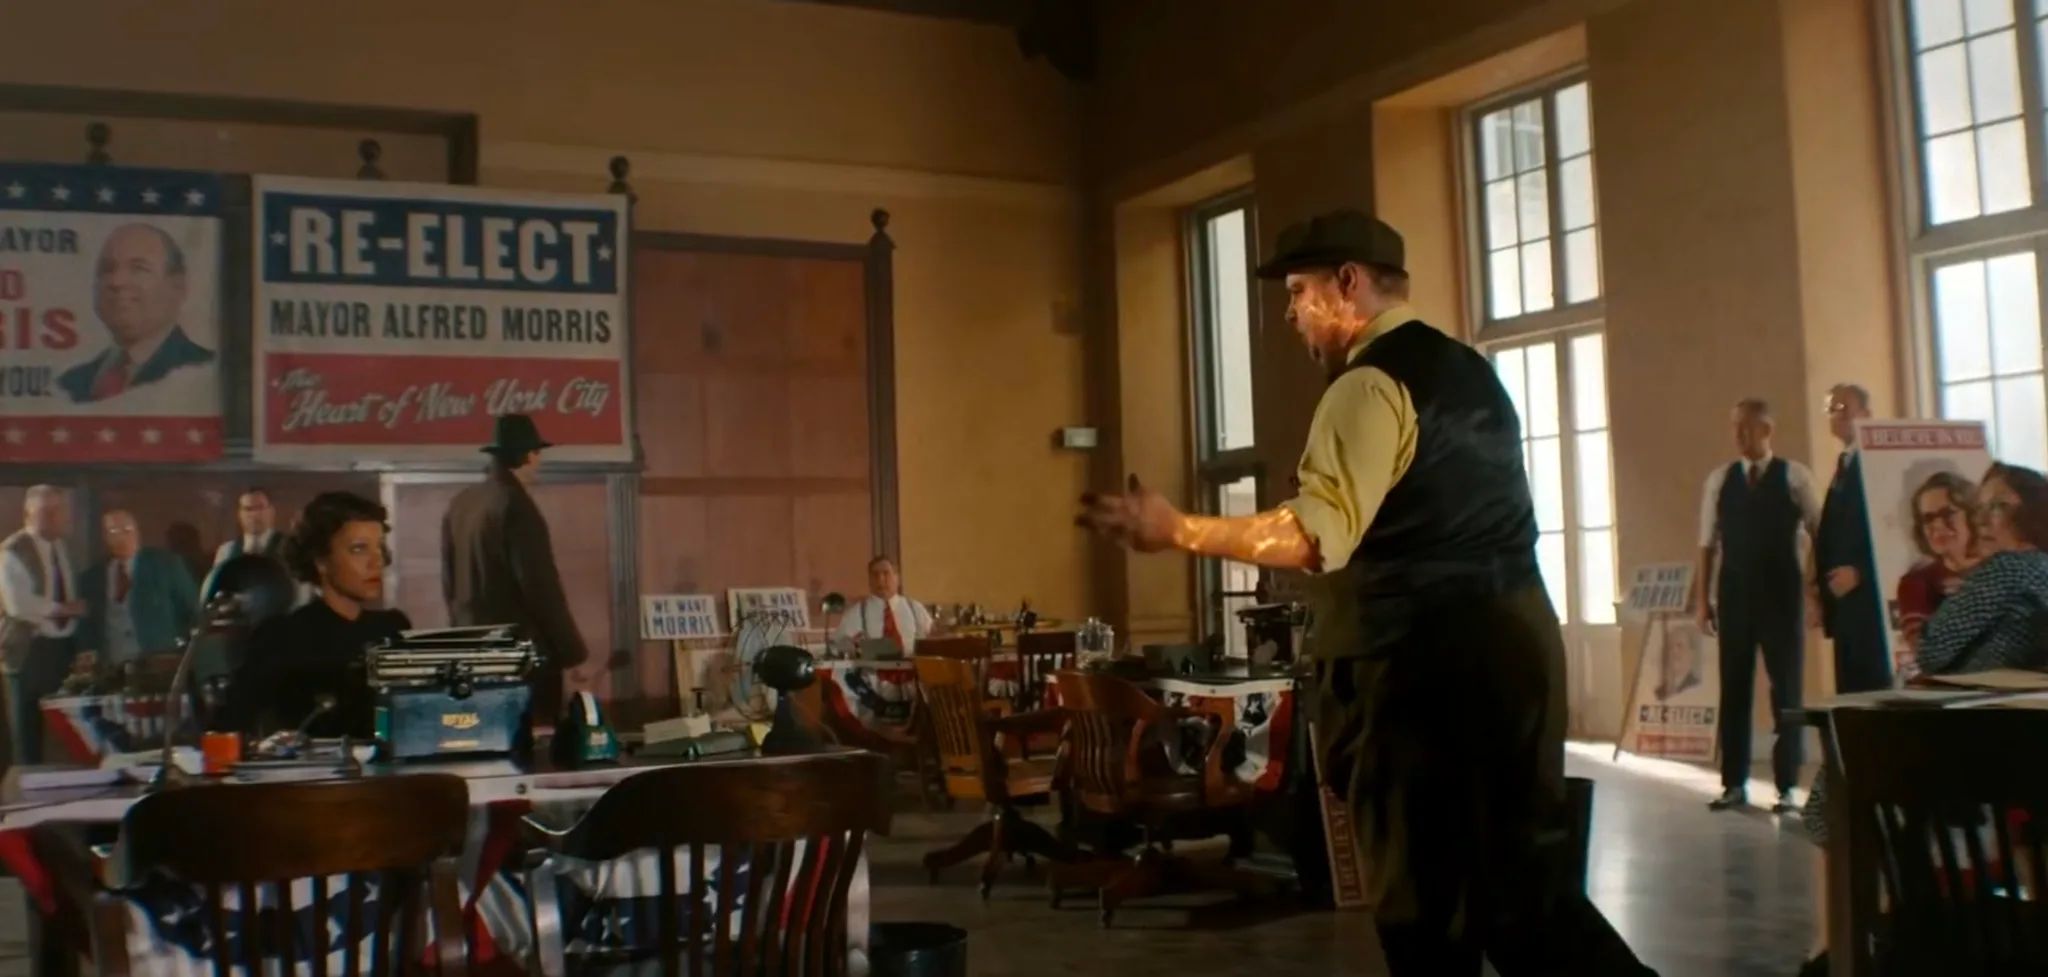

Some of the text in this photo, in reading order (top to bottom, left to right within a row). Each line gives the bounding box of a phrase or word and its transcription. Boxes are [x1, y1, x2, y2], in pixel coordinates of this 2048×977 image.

[289, 206, 599, 284] RE-ELECT
[0, 308, 79, 352] IS
[270, 300, 611, 345] MAYOR ALFRED MORRIS
[281, 376, 609, 431] Heart of New York City
[653, 600, 708, 612] WE WANT
[1630, 585, 1686, 609] MORRIS
[652, 615, 714, 636] MORRIS
